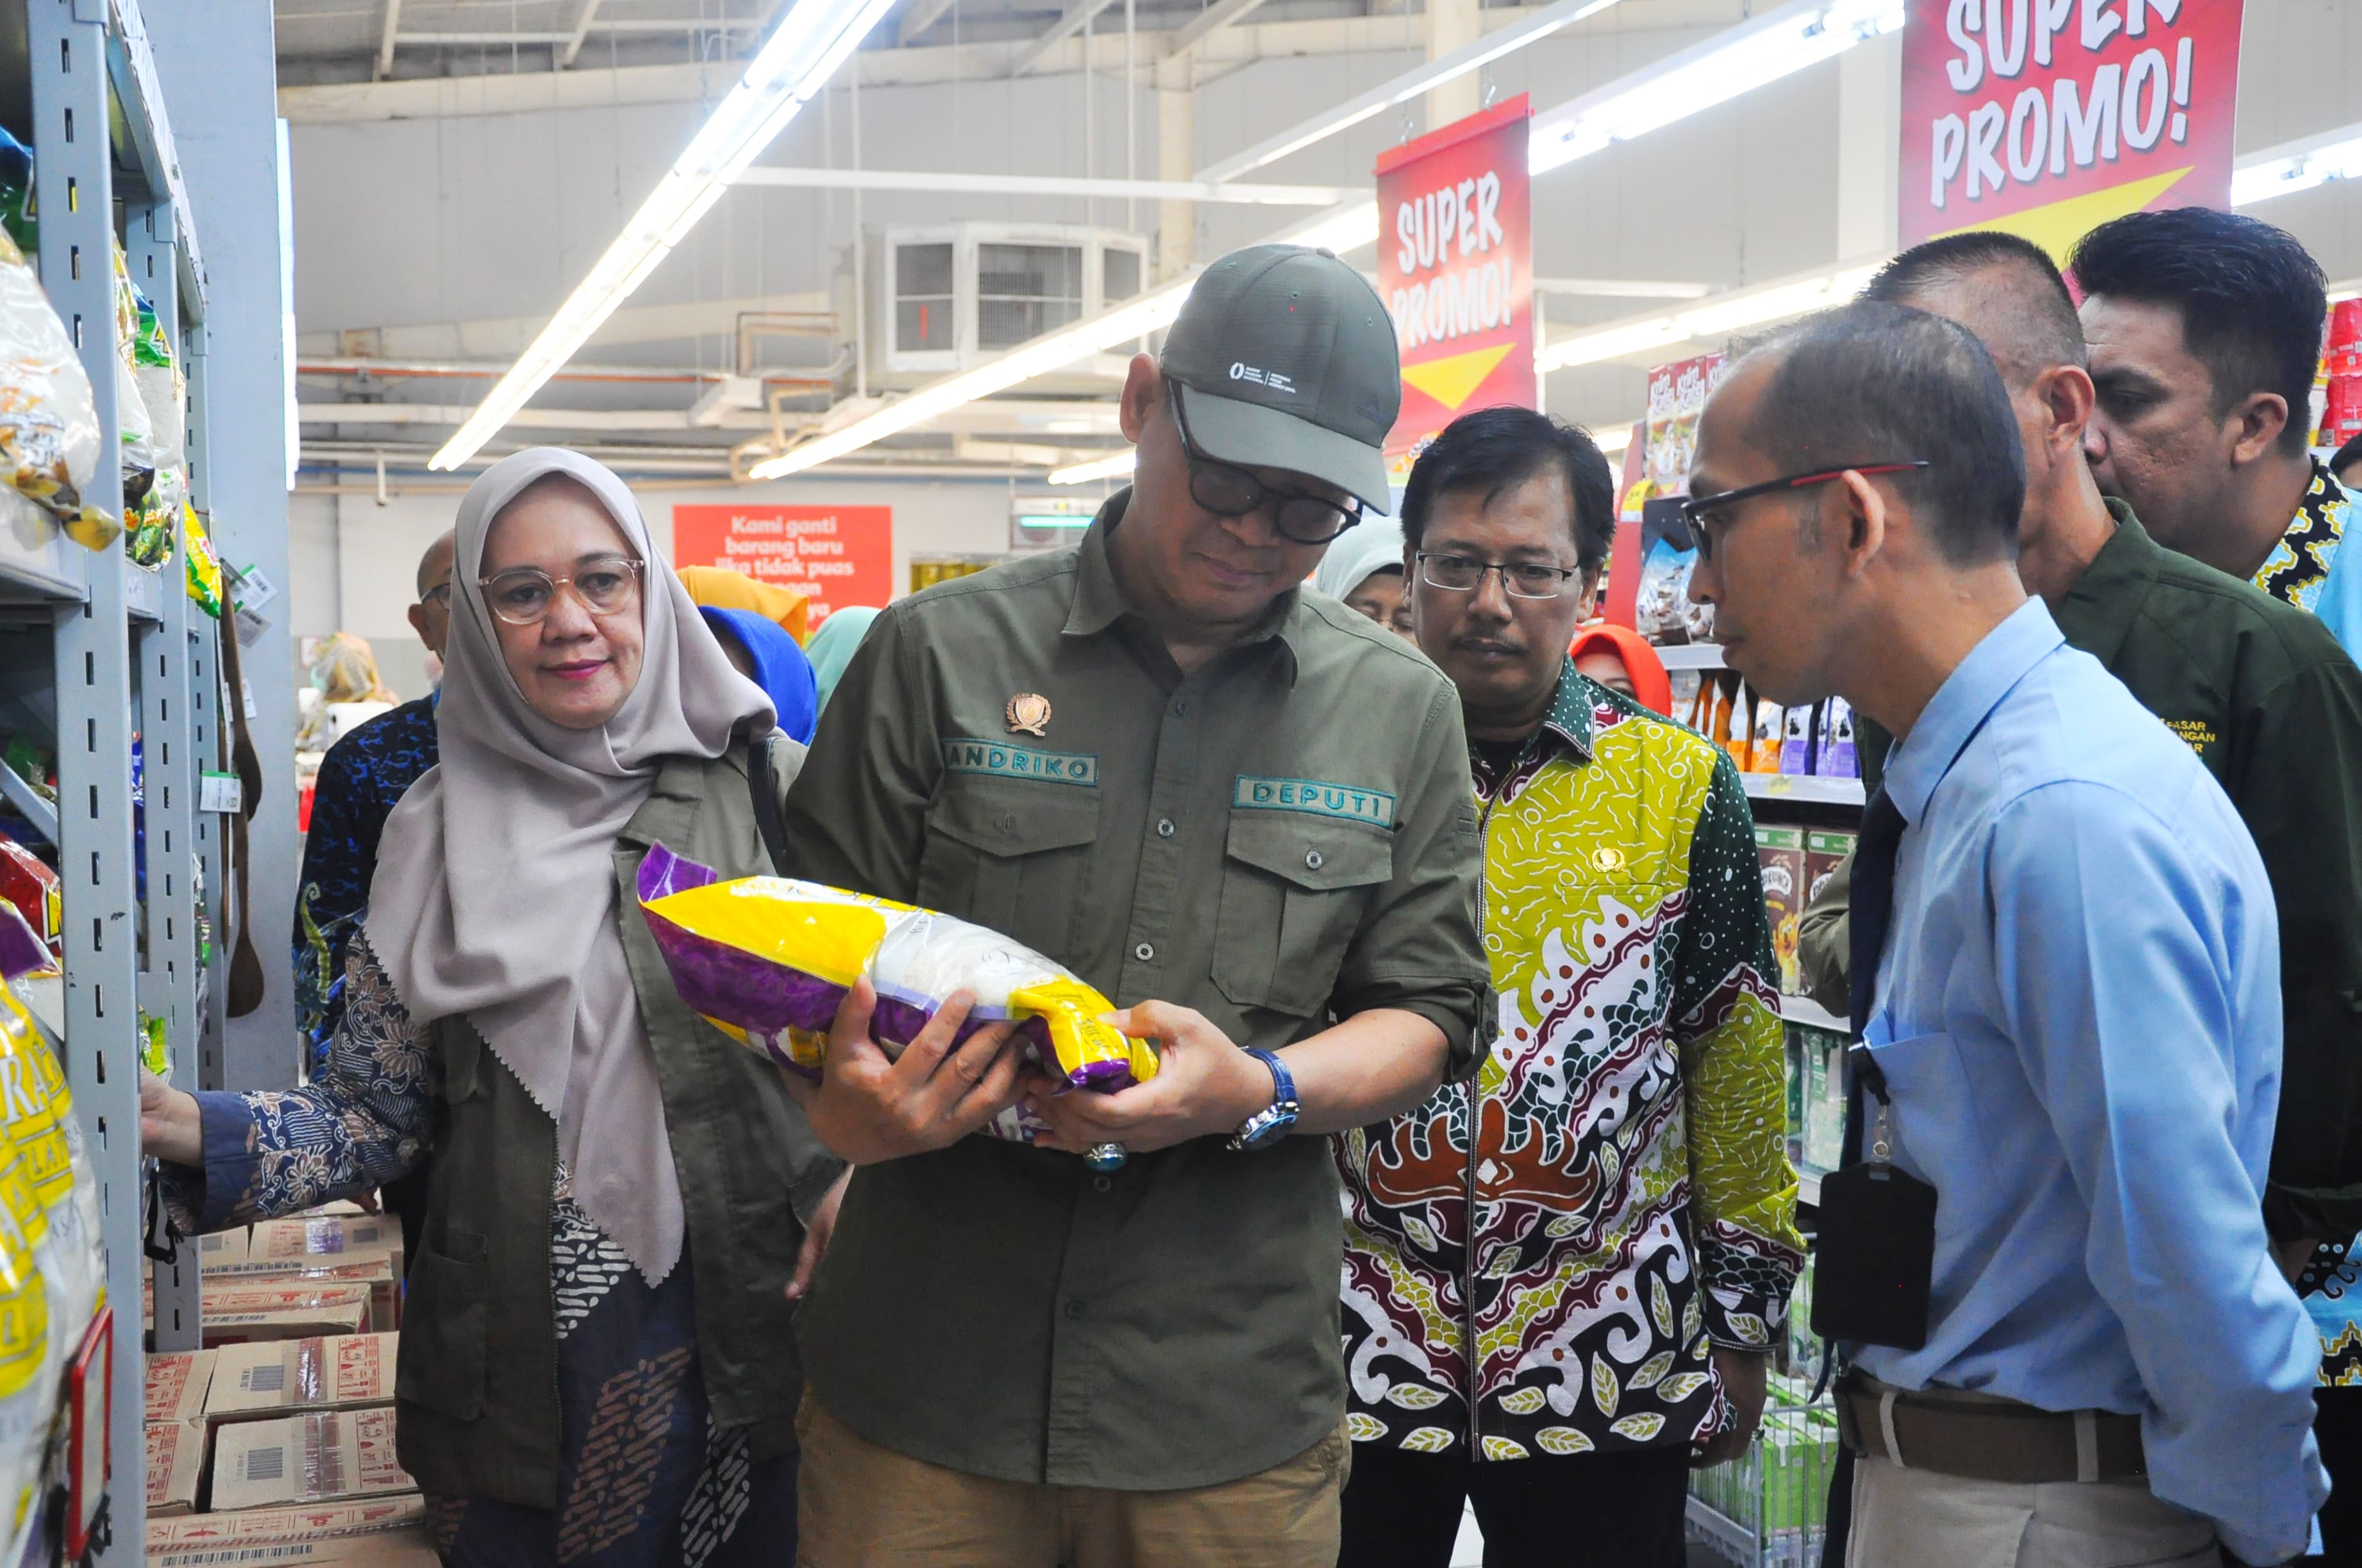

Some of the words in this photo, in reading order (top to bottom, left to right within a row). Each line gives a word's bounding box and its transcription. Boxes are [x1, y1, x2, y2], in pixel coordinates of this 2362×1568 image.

[1931, 37, 2193, 209] PROMO!
[1396, 170, 1503, 275] SUPER
[1393, 256, 1511, 349] PROMO!
[732, 516, 783, 534] Kami
[785, 516, 837, 538] ganti
[725, 536, 796, 559] barang
[798, 536, 844, 555] baru
[755, 556, 806, 576] tidak
[808, 561, 855, 580] puas
[2177, 731, 2216, 742] NGAN
[948, 746, 1089, 779] ANDRIKO
[1252, 782, 1380, 818] DEPUTI
